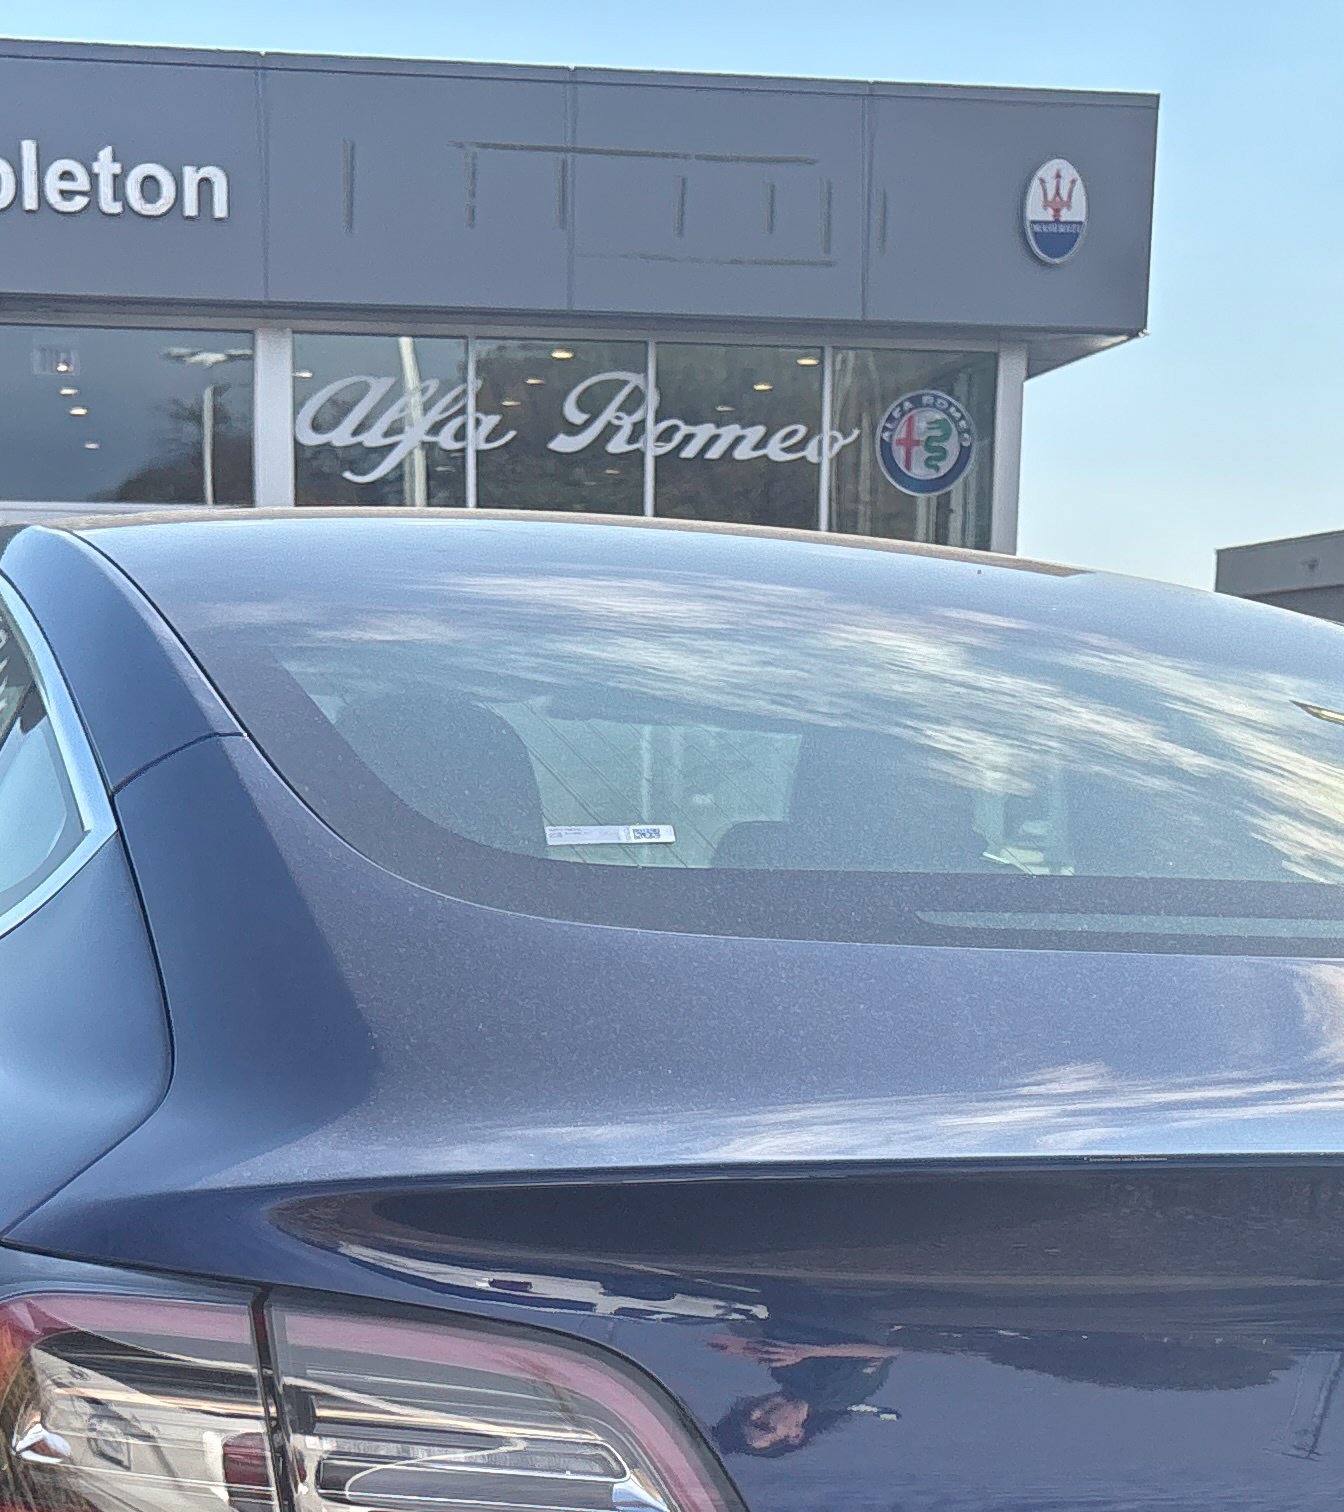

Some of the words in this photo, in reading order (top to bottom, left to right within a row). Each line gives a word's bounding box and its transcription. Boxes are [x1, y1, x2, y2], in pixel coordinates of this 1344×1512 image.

[294, 375, 517, 483] Alfa
[547, 371, 861, 463] Romeo
[882, 401, 913, 442] ALFA
[922, 395, 972, 447] ROMEO
